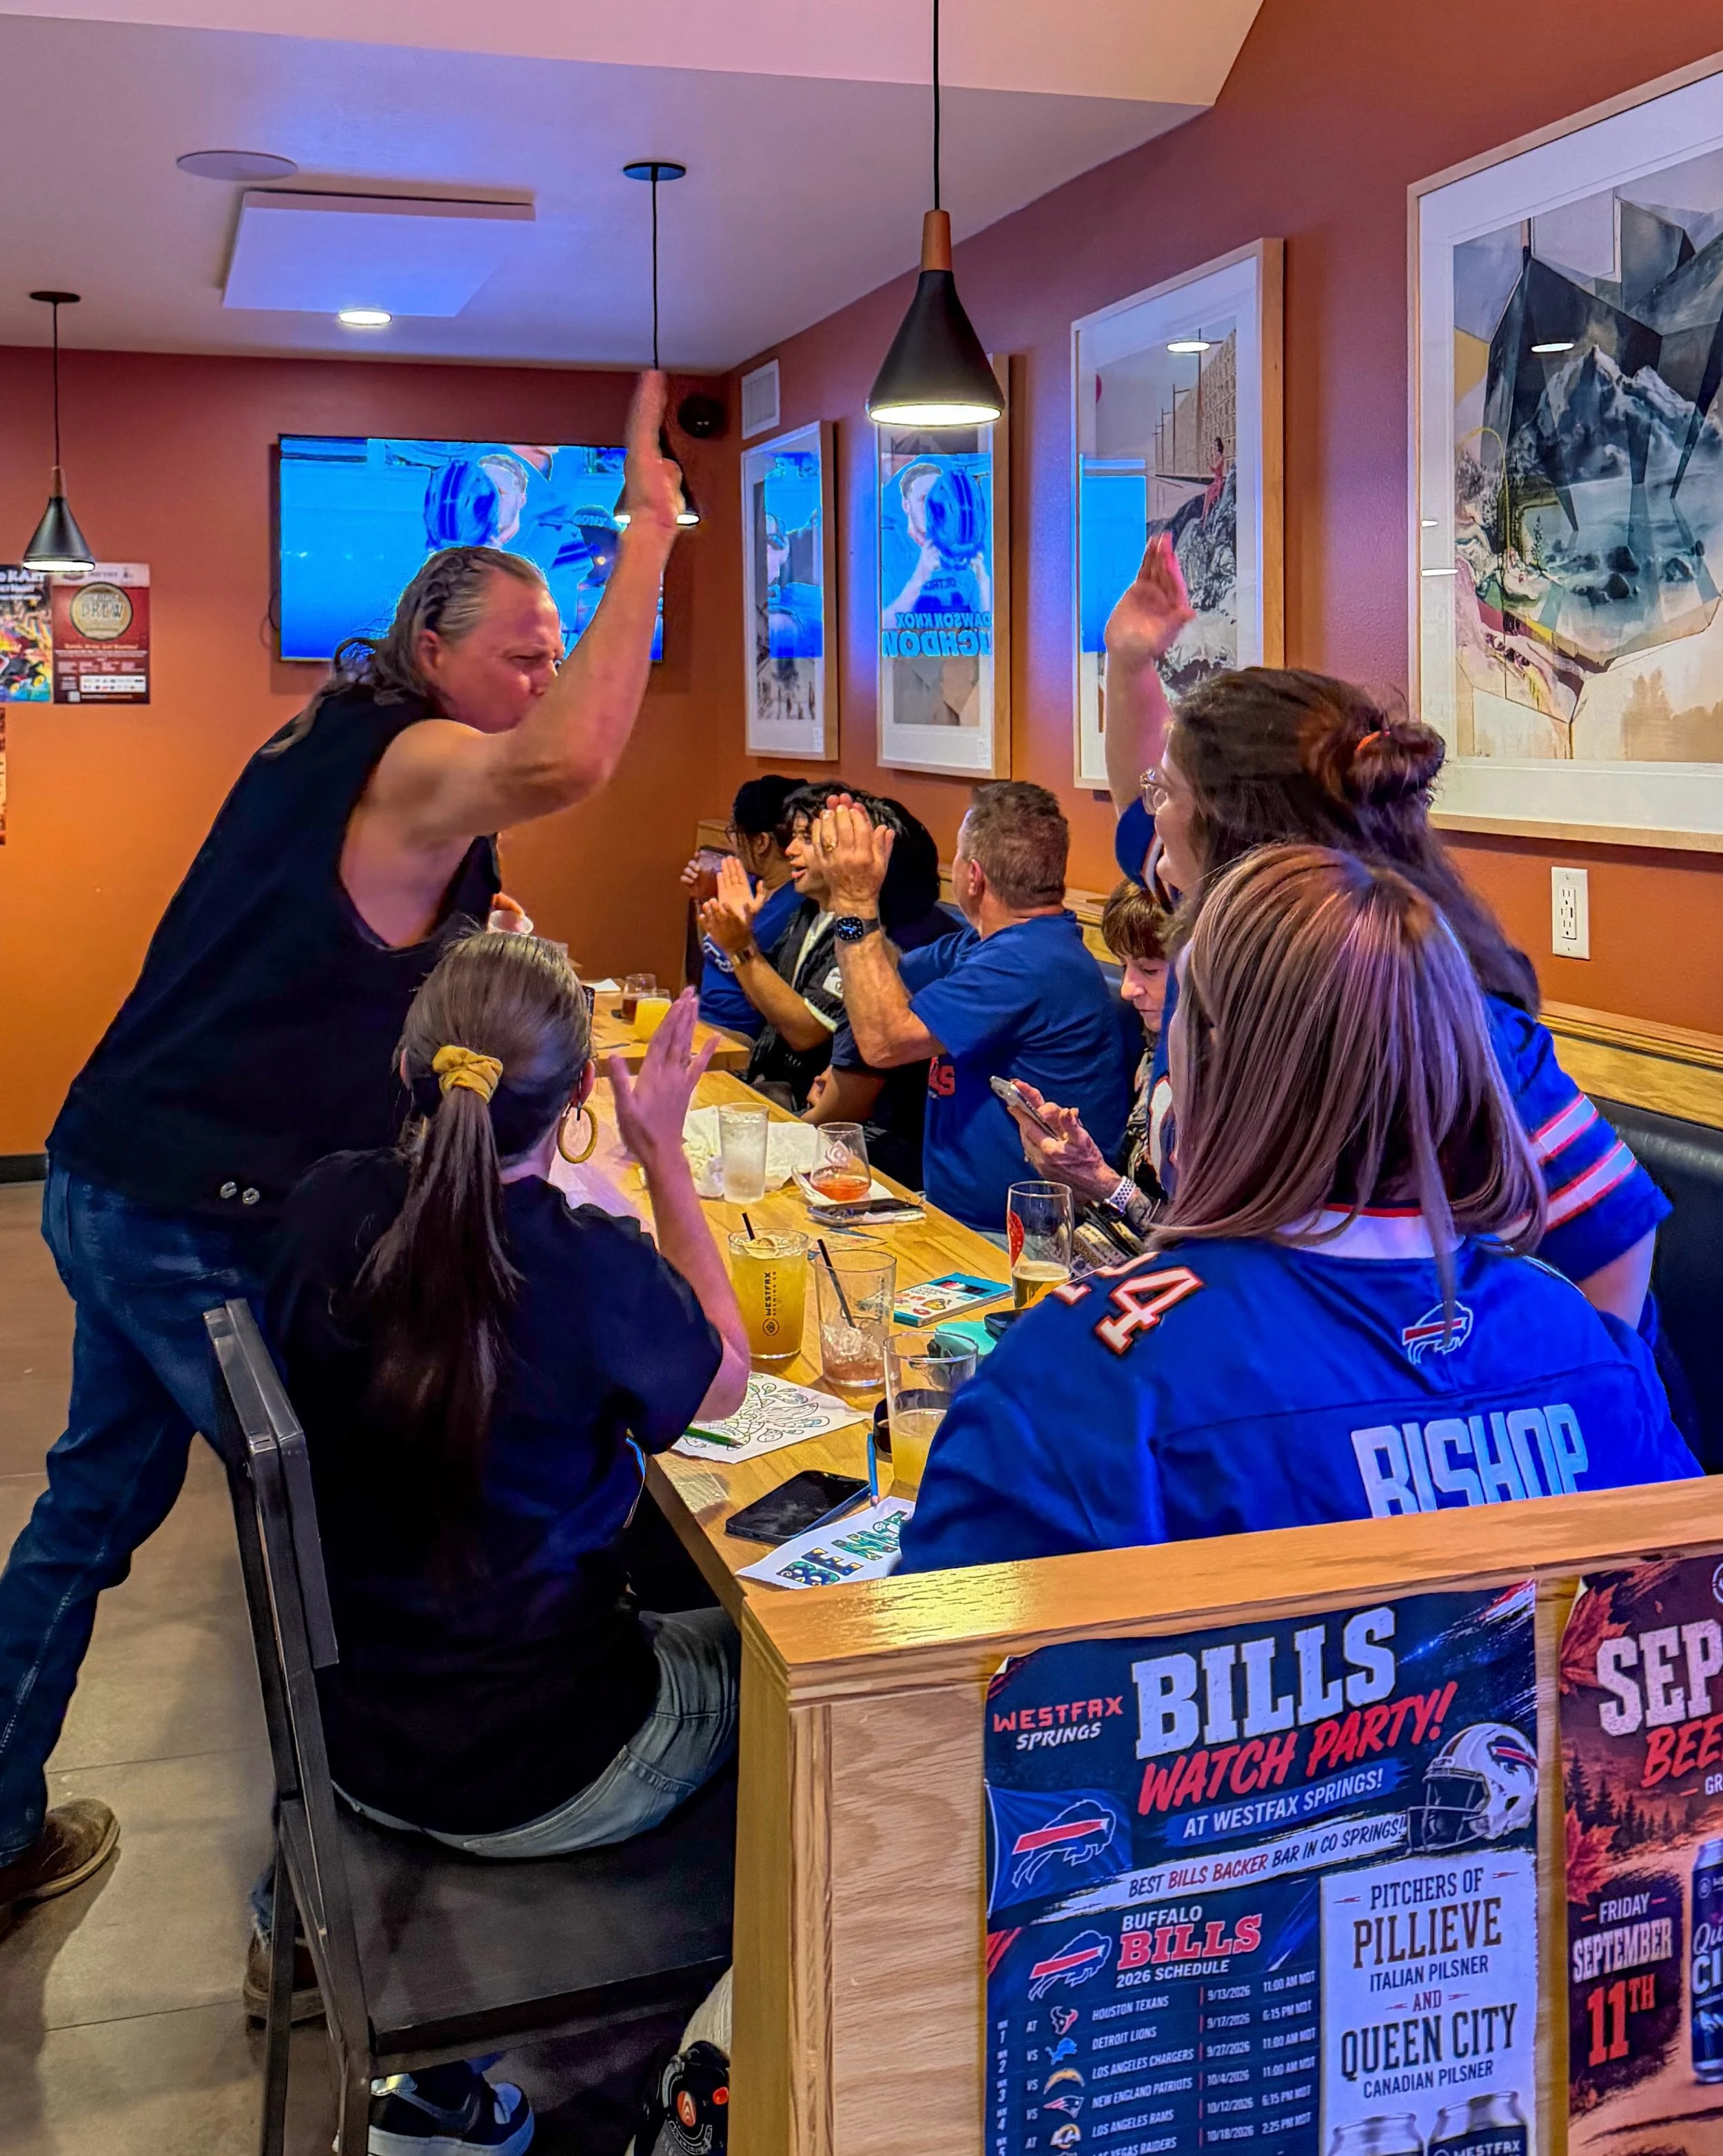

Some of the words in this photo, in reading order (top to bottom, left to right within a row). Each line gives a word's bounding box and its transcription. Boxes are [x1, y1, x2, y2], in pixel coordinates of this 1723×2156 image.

[764, 1272, 772, 1316] WESTFAX
[1351, 1403, 1588, 1518] BISHOP
[775, 1547, 865, 1586] BE
[1131, 1606, 1396, 1760] BILLS
[1597, 1619, 1723, 1737] SEP
[993, 1695, 1124, 1733] WESTFAX
[1016, 1722, 1102, 1751] SPRINGS
[1138, 1732, 1298, 1816] WATCH
[1306, 1681, 1458, 1777] PARTY!
[1641, 1713, 1723, 1788] BEE
[1183, 1815, 1209, 1839] AT
[1213, 1795, 1298, 1831] WESTFAX
[1303, 1767, 1383, 1812] SPRINGS!
[1705, 1773, 1723, 1796] GR
[1128, 1873, 1165, 1897] BEST
[1168, 1865, 1209, 1889] BILLS
[1212, 1854, 1268, 1882] BACKER
[1272, 1843, 1300, 1868] BAR
[1303, 1838, 1318, 1858] IN
[1321, 1833, 1338, 1852] CO
[1370, 1872, 1457, 1911] PITCHERS
[1462, 1867, 1485, 1894] OF
[1599, 1892, 1651, 1924] FRIDAY
[1121, 1904, 1203, 1931] BUFFALO
[1353, 1897, 1502, 1970] PILLIEVE
[1115, 1913, 1262, 1971] BILLS
[1572, 1917, 1673, 1984] SEPTEMBER
[1115, 1969, 1152, 1989] 2026
[1154, 1960, 1230, 1982] SCHEDULE
[1370, 1966, 1424, 1993] ITALIAN
[1429, 1955, 1489, 1982] PILSNER
[1092, 2002, 1134, 2021] HOUSTON
[1134, 1995, 1169, 2013] TEXANS
[1412, 1989, 1442, 2013] AND
[1587, 1973, 1655, 2067] 11TH
[1026, 2020, 1038, 2033] AT
[1092, 2031, 1130, 2051] DETROIT
[1130, 2026, 1157, 2043] LIONS
[1341, 2015, 1442, 2082] QUEEN
[1452, 2003, 1518, 2059] CITY
[1026, 2049, 1039, 2062] VS
[1092, 2066, 1109, 2080] LOS
[1110, 2056, 1148, 2076] ANGELES
[1149, 2048, 1195, 2067] CHARGERS
[1026, 2079, 1039, 2091] VS
[1092, 2094, 1112, 2109] NEW
[1112, 2084, 1152, 2104] ENGLAND
[1152, 2077, 1193, 2094] PATRIOTS
[1363, 2071, 1434, 2099] CANADIAN
[1438, 2060, 1493, 2087] PILSNER
[1026, 2108, 1039, 2120] VS
[1092, 2124, 1109, 2138] LOS
[1110, 2114, 1149, 2135] ANGELES
[1149, 2109, 1174, 2126] RAMS
[1025, 2137, 1037, 2150] AT
[1139, 2137, 1177, 2155] RAIDERS
